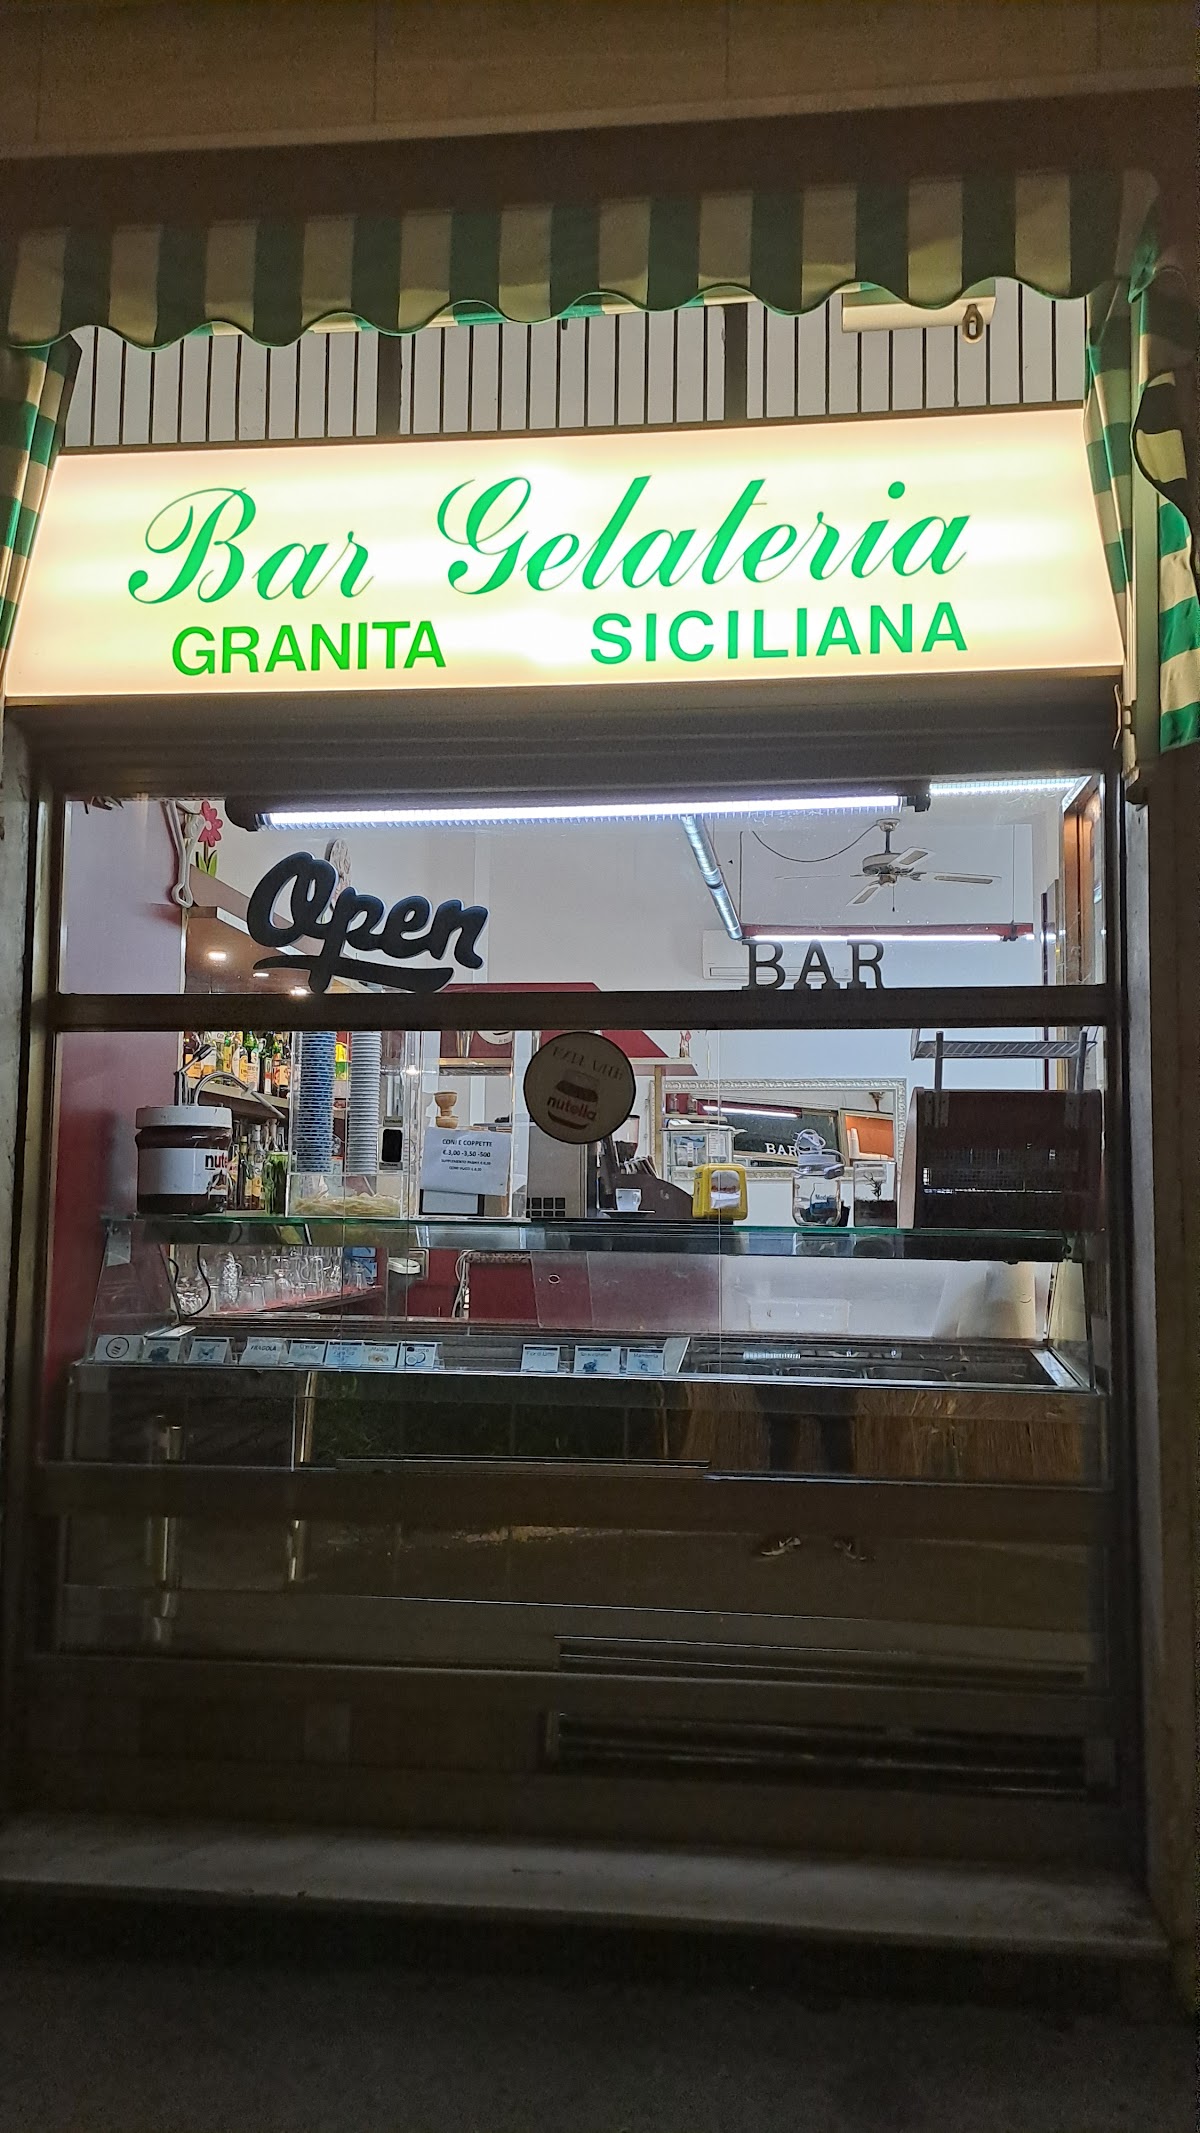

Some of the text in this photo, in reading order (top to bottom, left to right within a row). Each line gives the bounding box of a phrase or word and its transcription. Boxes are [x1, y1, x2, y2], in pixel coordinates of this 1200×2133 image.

[128, 475, 971, 605] Bar Gelateria
[171, 602, 969, 677] GRANITA SICILIANA
[246, 851, 489, 994] Open
[742, 939, 886, 989] BAR
[547, 1096, 598, 1121] nutella
